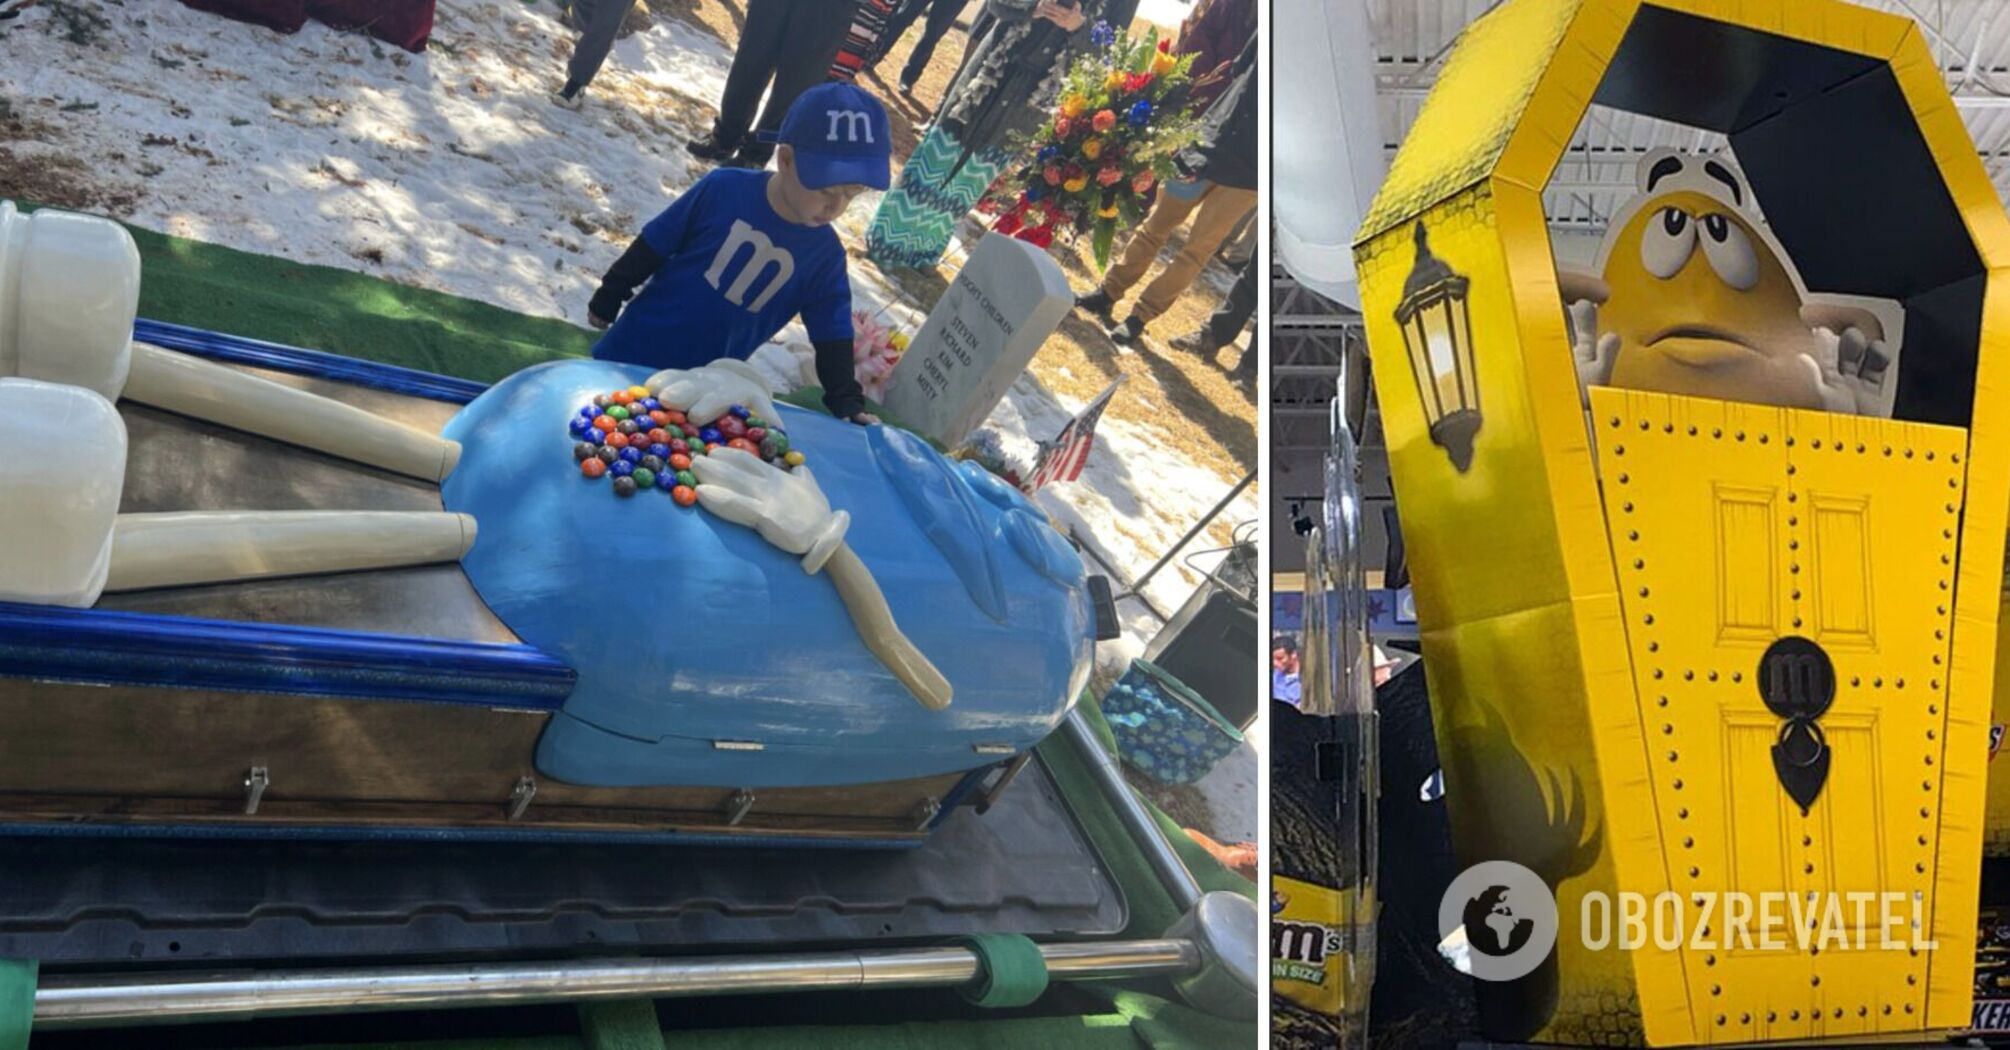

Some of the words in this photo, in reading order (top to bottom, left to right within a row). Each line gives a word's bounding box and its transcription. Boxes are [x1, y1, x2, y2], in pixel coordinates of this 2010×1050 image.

[826, 109, 875, 143] m
[704, 218, 795, 313] m
[951, 315, 978, 349] STEVEN
[980, 297, 1014, 335] CHILDREN
[938, 351, 953, 370] KIM
[940, 327, 971, 366] RICHARD
[917, 373, 938, 400] MISTY
[923, 357, 949, 391] CHERYL
[1769, 653, 1823, 704] m
[1289, 965, 1323, 983] SIZE
